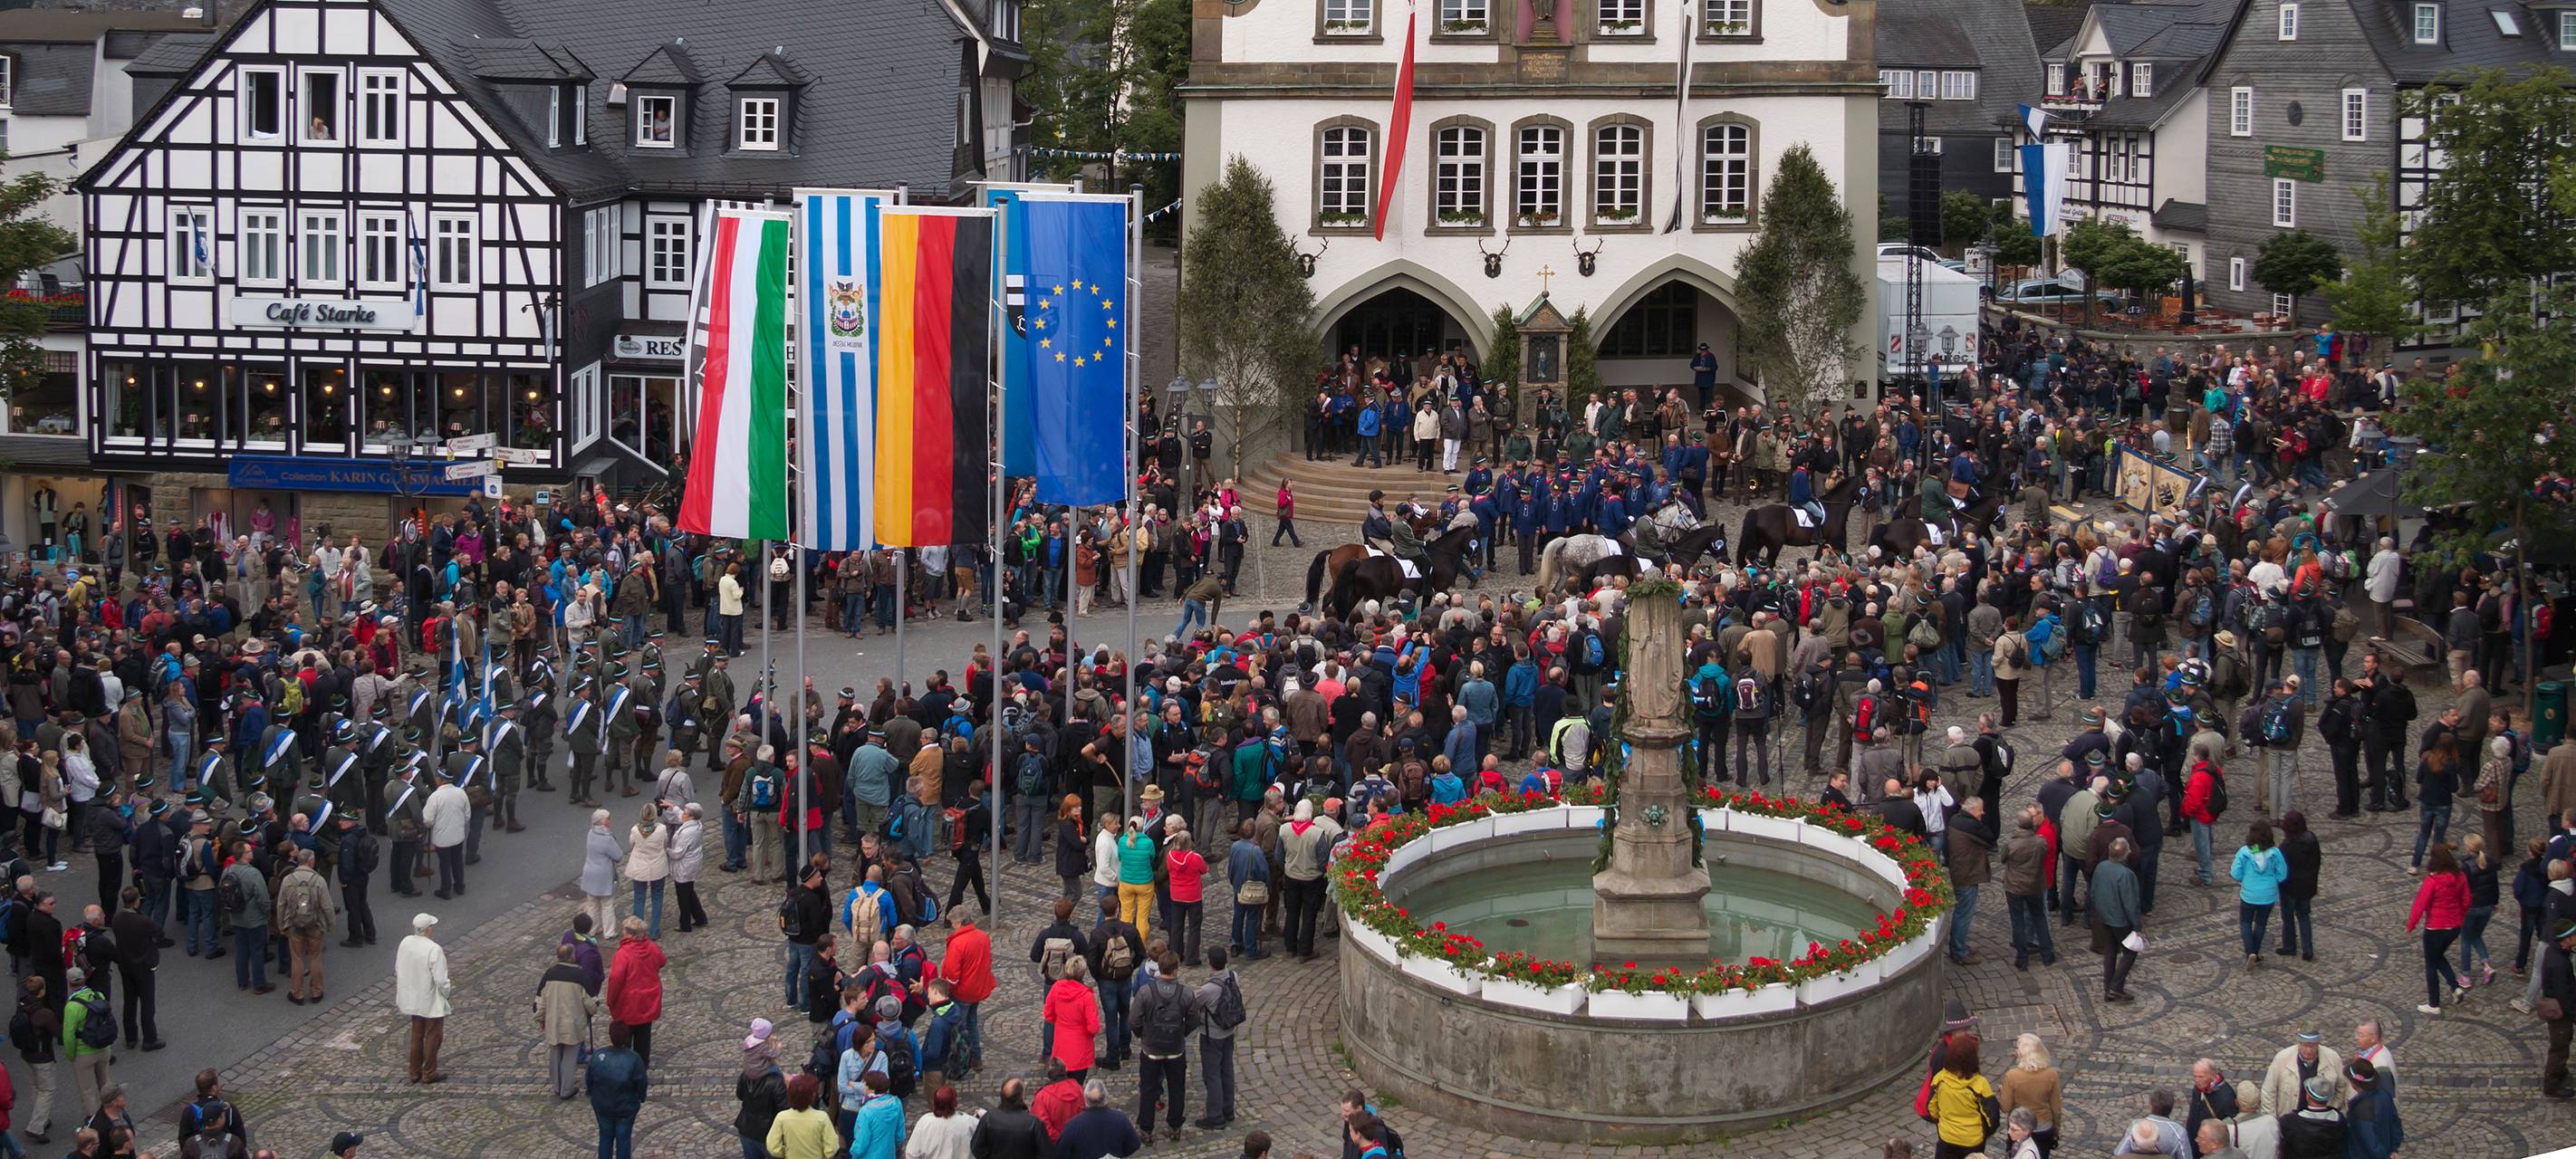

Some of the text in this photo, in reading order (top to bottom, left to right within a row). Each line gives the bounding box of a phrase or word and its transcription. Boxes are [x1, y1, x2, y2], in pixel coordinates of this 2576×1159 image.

[266, 303, 376, 324] Café Starke
[646, 340, 685, 356] RES
[330, 471, 376, 484] KARIN
